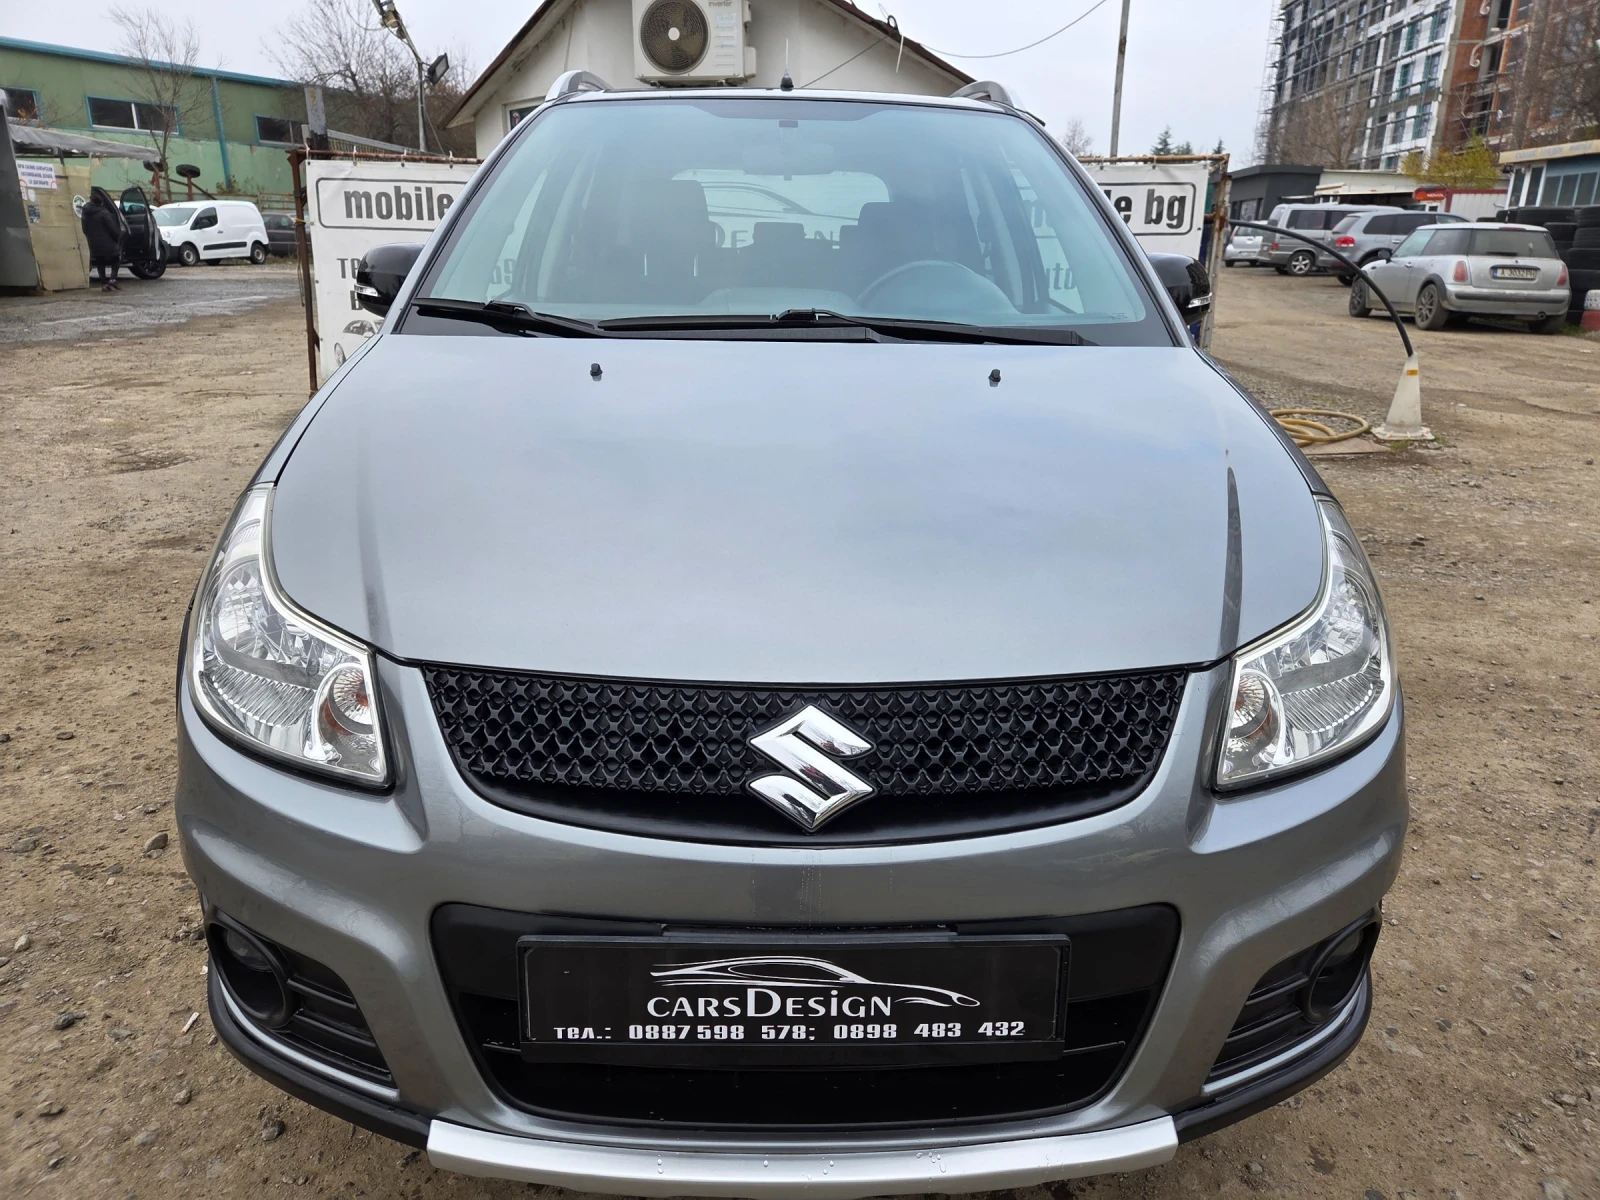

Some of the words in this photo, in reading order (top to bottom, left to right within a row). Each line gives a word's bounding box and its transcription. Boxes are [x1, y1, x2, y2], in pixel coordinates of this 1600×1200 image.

[344, 185, 454, 221] mobile
[1144, 189, 1187, 229] bg
[628, 1024, 691, 1040] 0887
[697, 1024, 745, 1040] 598
[833, 1024, 897, 1039] 0898
[913, 1022, 962, 1037] 483
[977, 1021, 1025, 1036] 432
